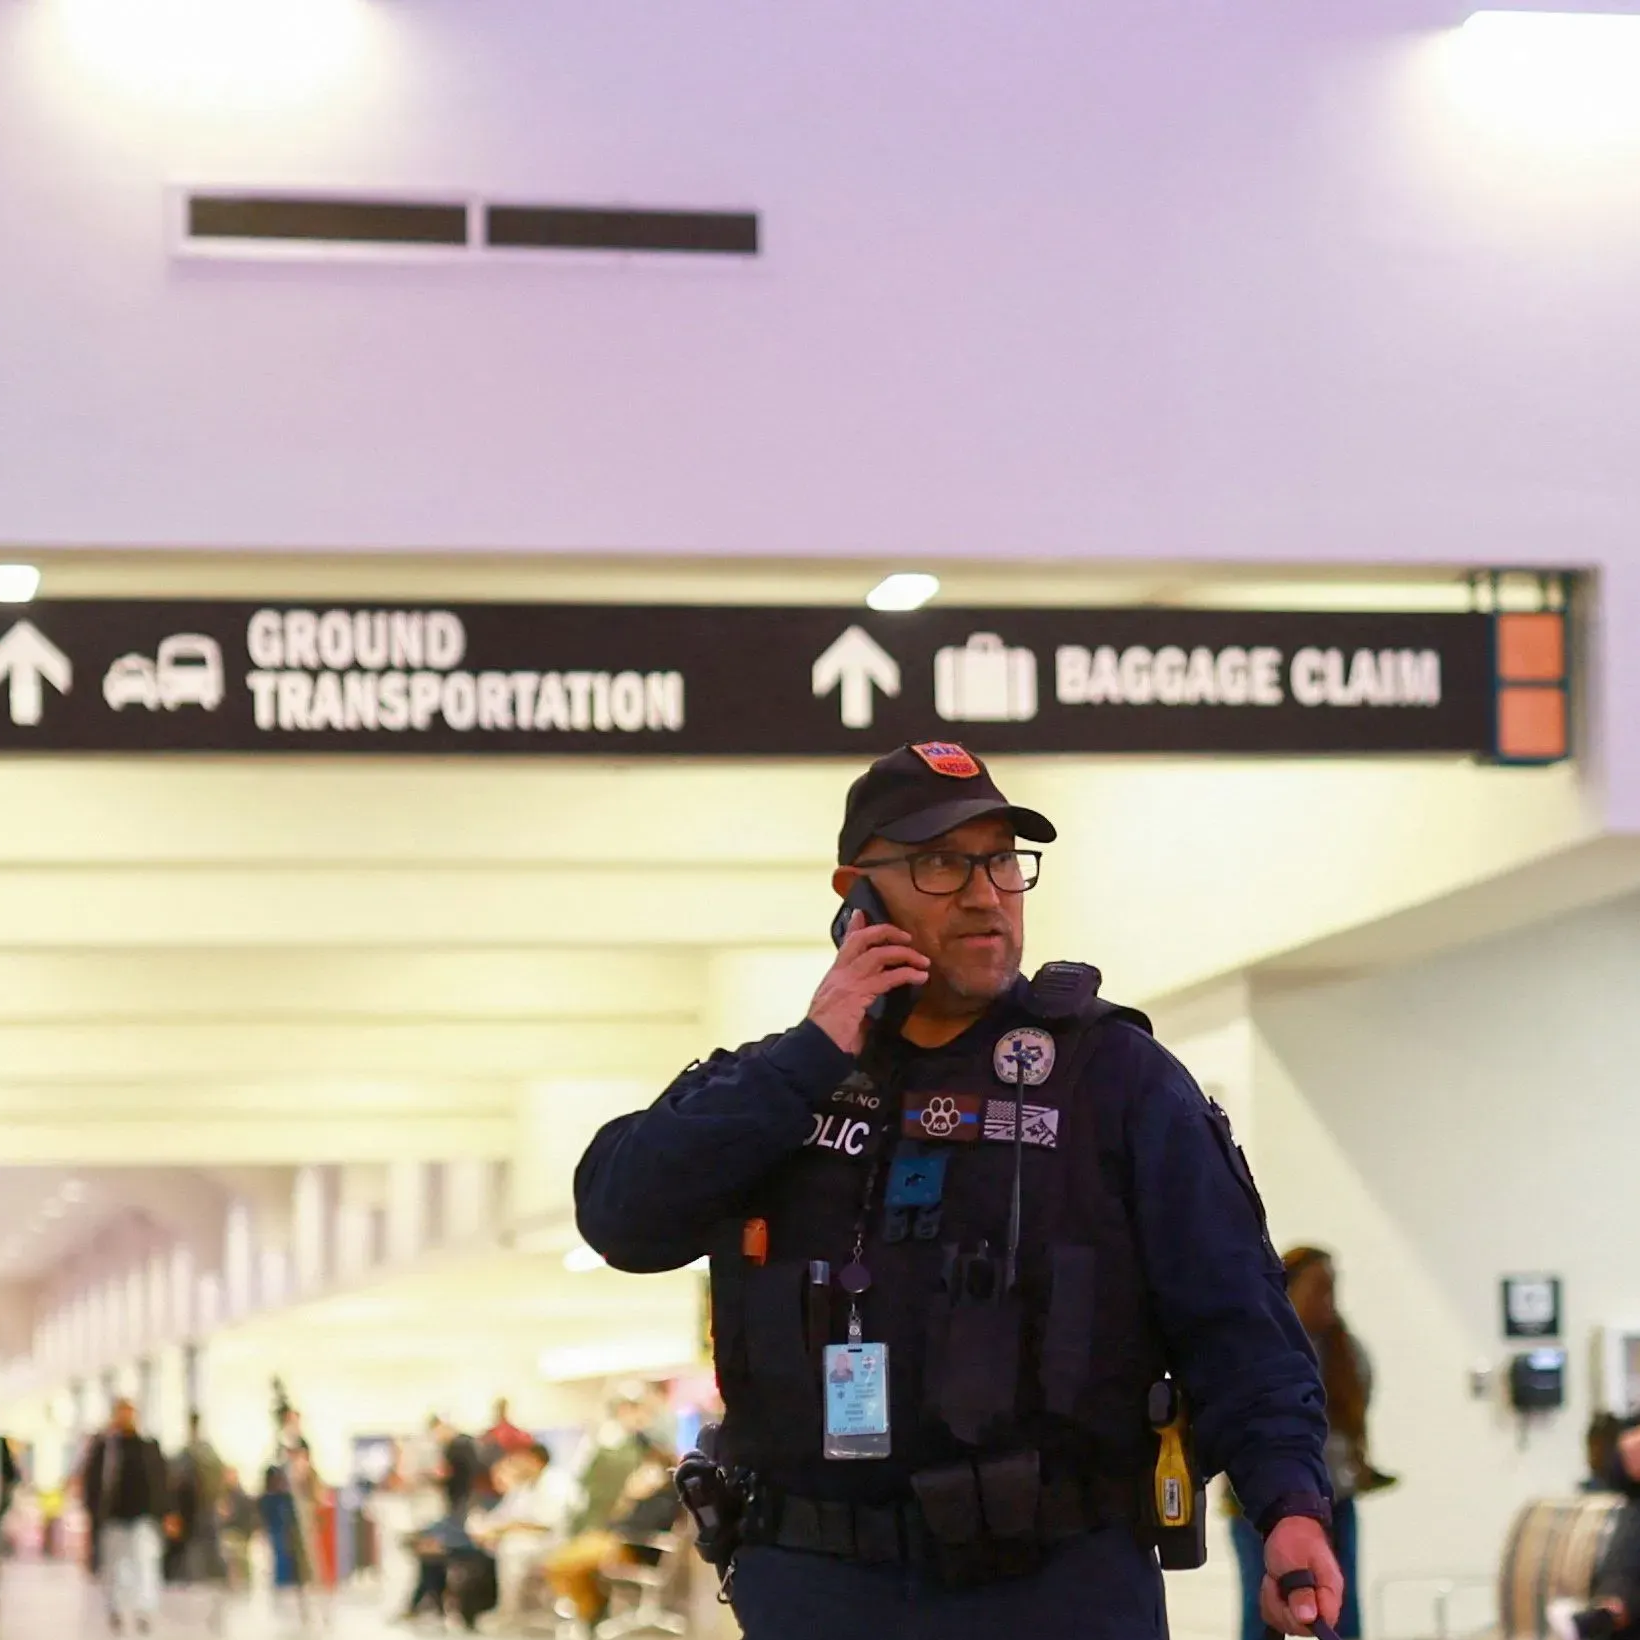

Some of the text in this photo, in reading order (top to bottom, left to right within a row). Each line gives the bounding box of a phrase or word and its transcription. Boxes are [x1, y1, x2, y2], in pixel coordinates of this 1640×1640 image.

[247, 610, 467, 669] GROUND
[247, 671, 685, 731] TRANSPORTATION
[1056, 645, 1441, 707] BAGGAGE CLAIM
[831, 1090, 880, 1110] CANO
[932, 1121, 947, 1131] K9
